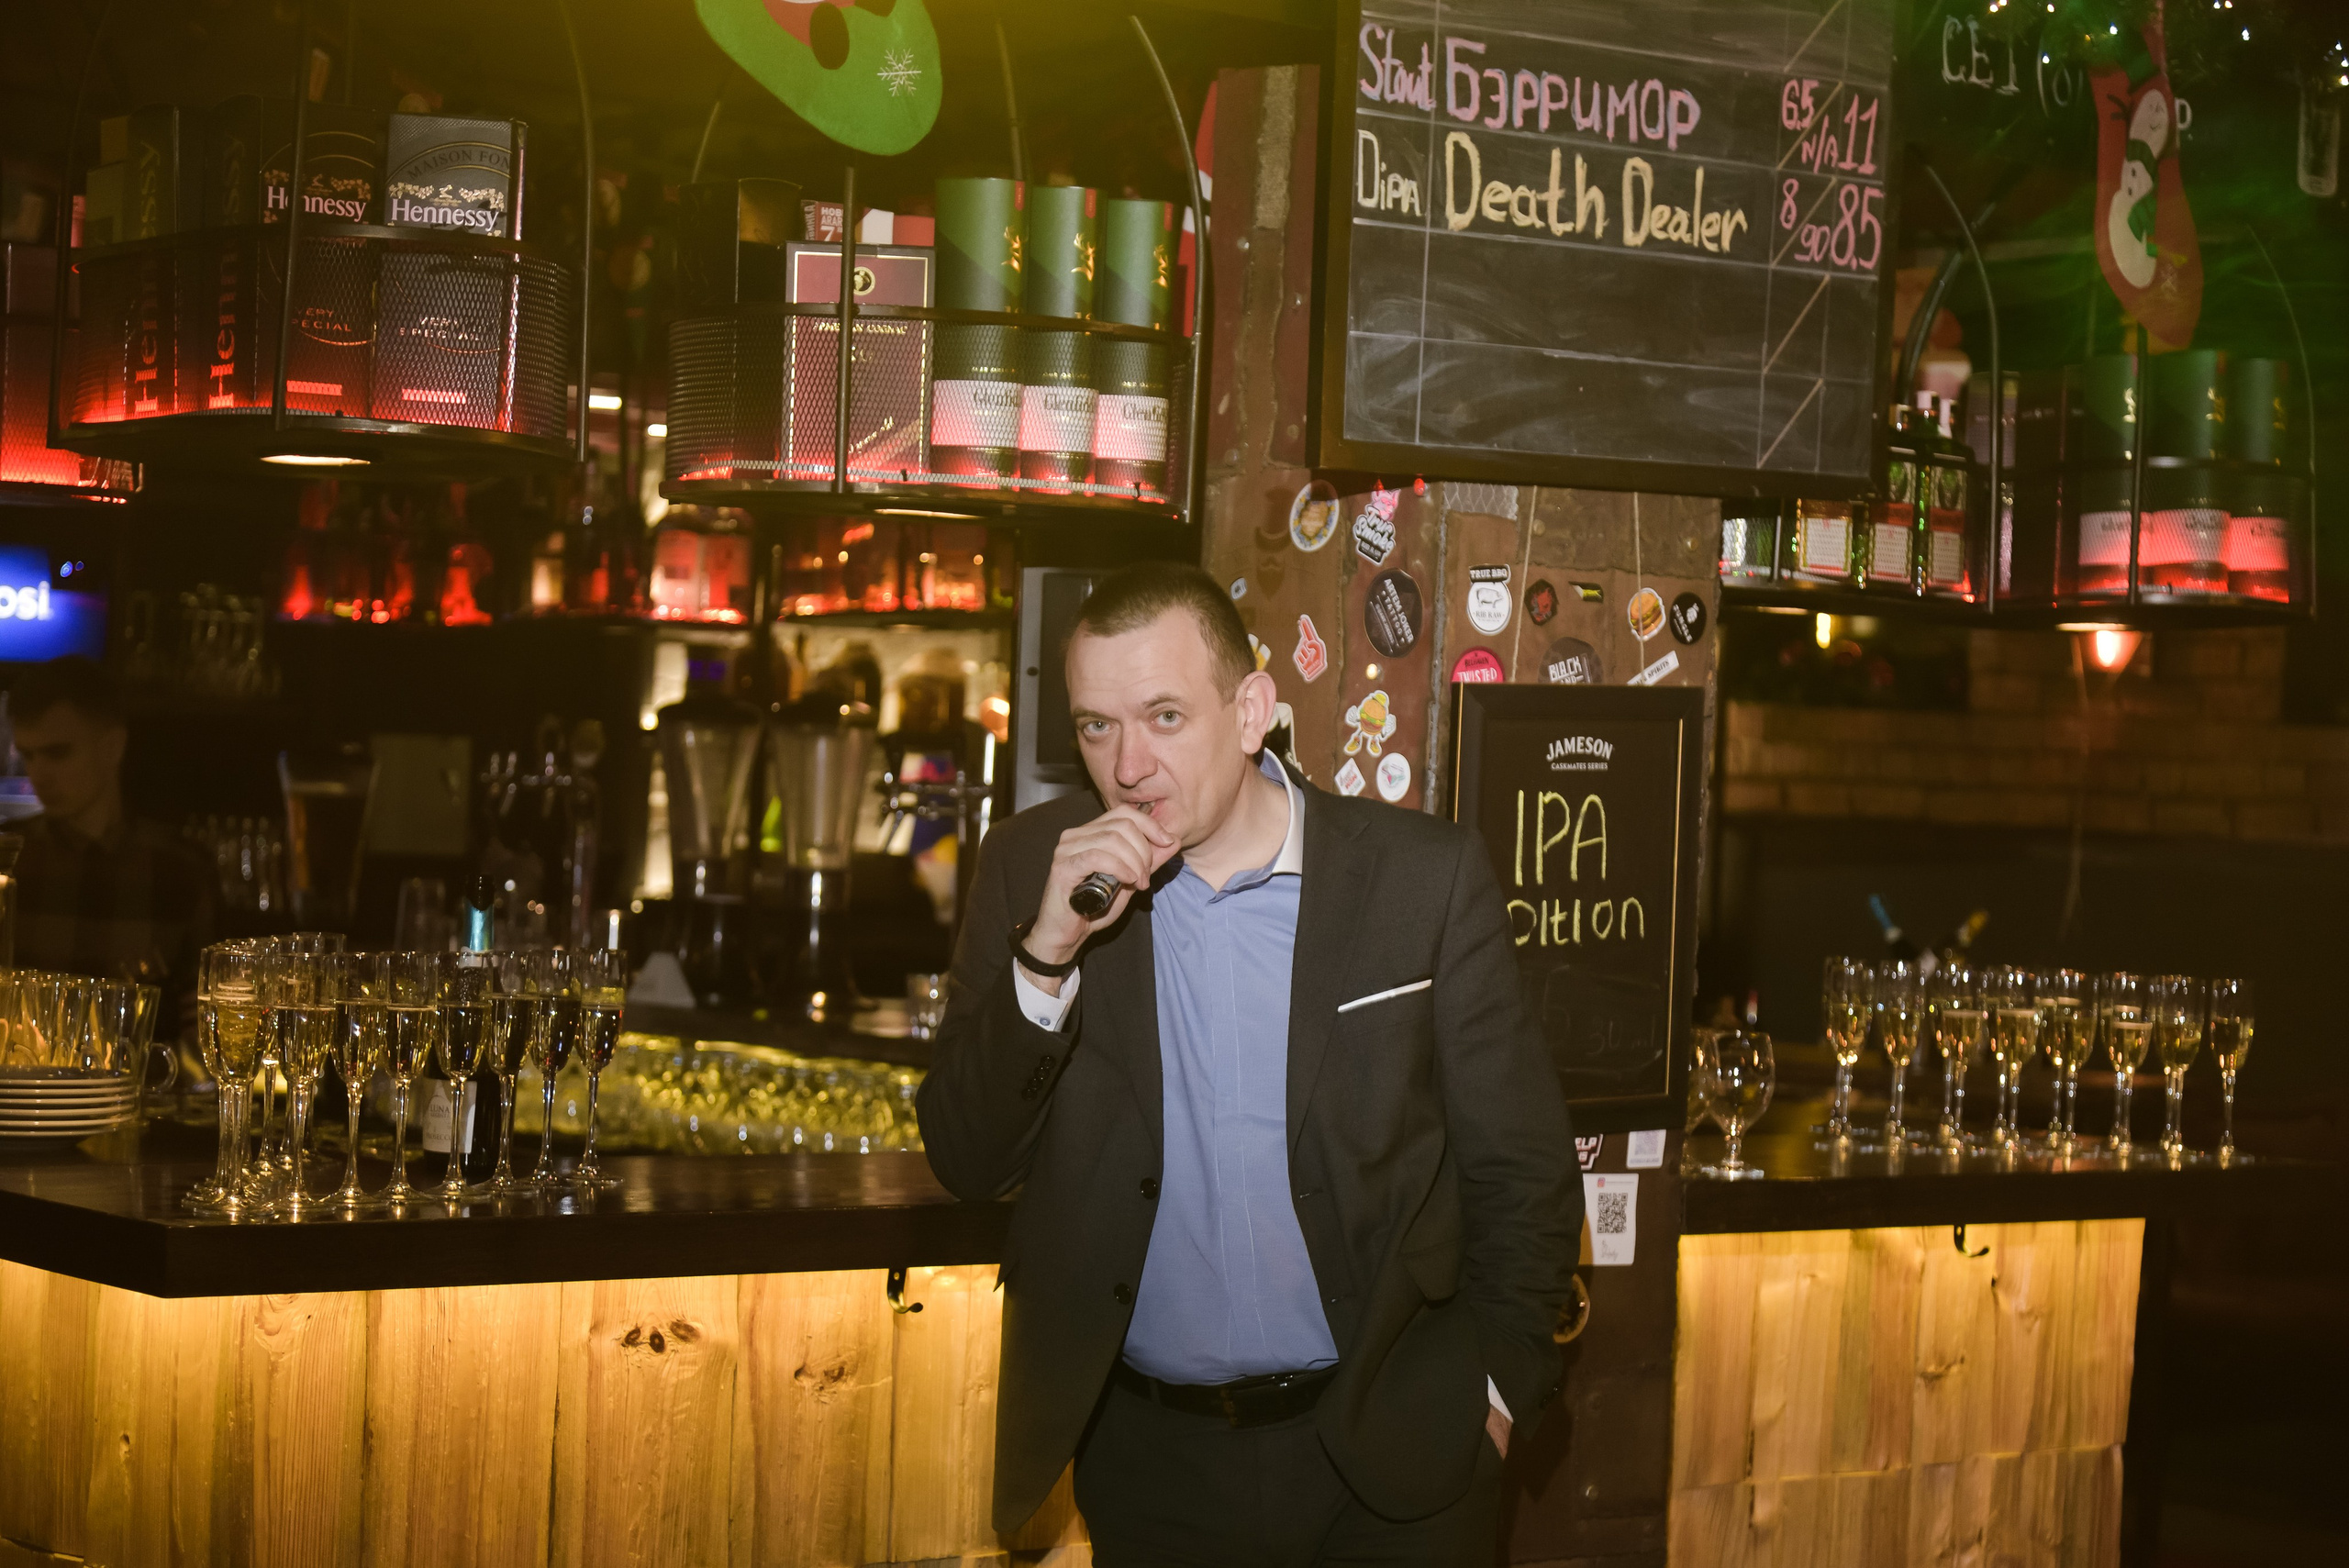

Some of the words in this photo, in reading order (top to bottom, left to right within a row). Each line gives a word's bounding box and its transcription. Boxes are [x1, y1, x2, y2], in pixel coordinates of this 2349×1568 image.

[1360, 22, 1437, 111] Stout
[1801, 114, 1839, 174] N/A
[1838, 93, 1879, 175] 11
[407, 150, 473, 182] MAISON
[267, 185, 367, 223] Hnnessy
[1445, 130, 1610, 240] Death
[1621, 156, 1749, 254] Dealer
[1779, 178, 1799, 229] 8
[391, 197, 500, 232] Hennessy
[804, 204, 816, 240] ВИНКА
[820, 206, 843, 217] НОВ
[1831, 183, 1885, 271] 8.5
[291, 318, 352, 332] PECIAL
[399, 327, 481, 341] SPECAL
[813, 321, 863, 333] ARMEAN
[1354, 516, 1395, 556] Smoke
[1469, 569, 1490, 579] TRUE
[1384, 578, 1403, 612] ARTEM
[1397, 611, 1414, 643] JOKER
[1385, 595, 1403, 636] TATTOO
[1457, 668, 1498, 683] TWISTED
[1548, 655, 1583, 682] BLACK
[1546, 736, 1613, 762] JAMESON
[1551, 762, 1586, 771] CASKMATES
[1587, 762, 1609, 771] SERIES
[1515, 789, 1607, 887] IPA
